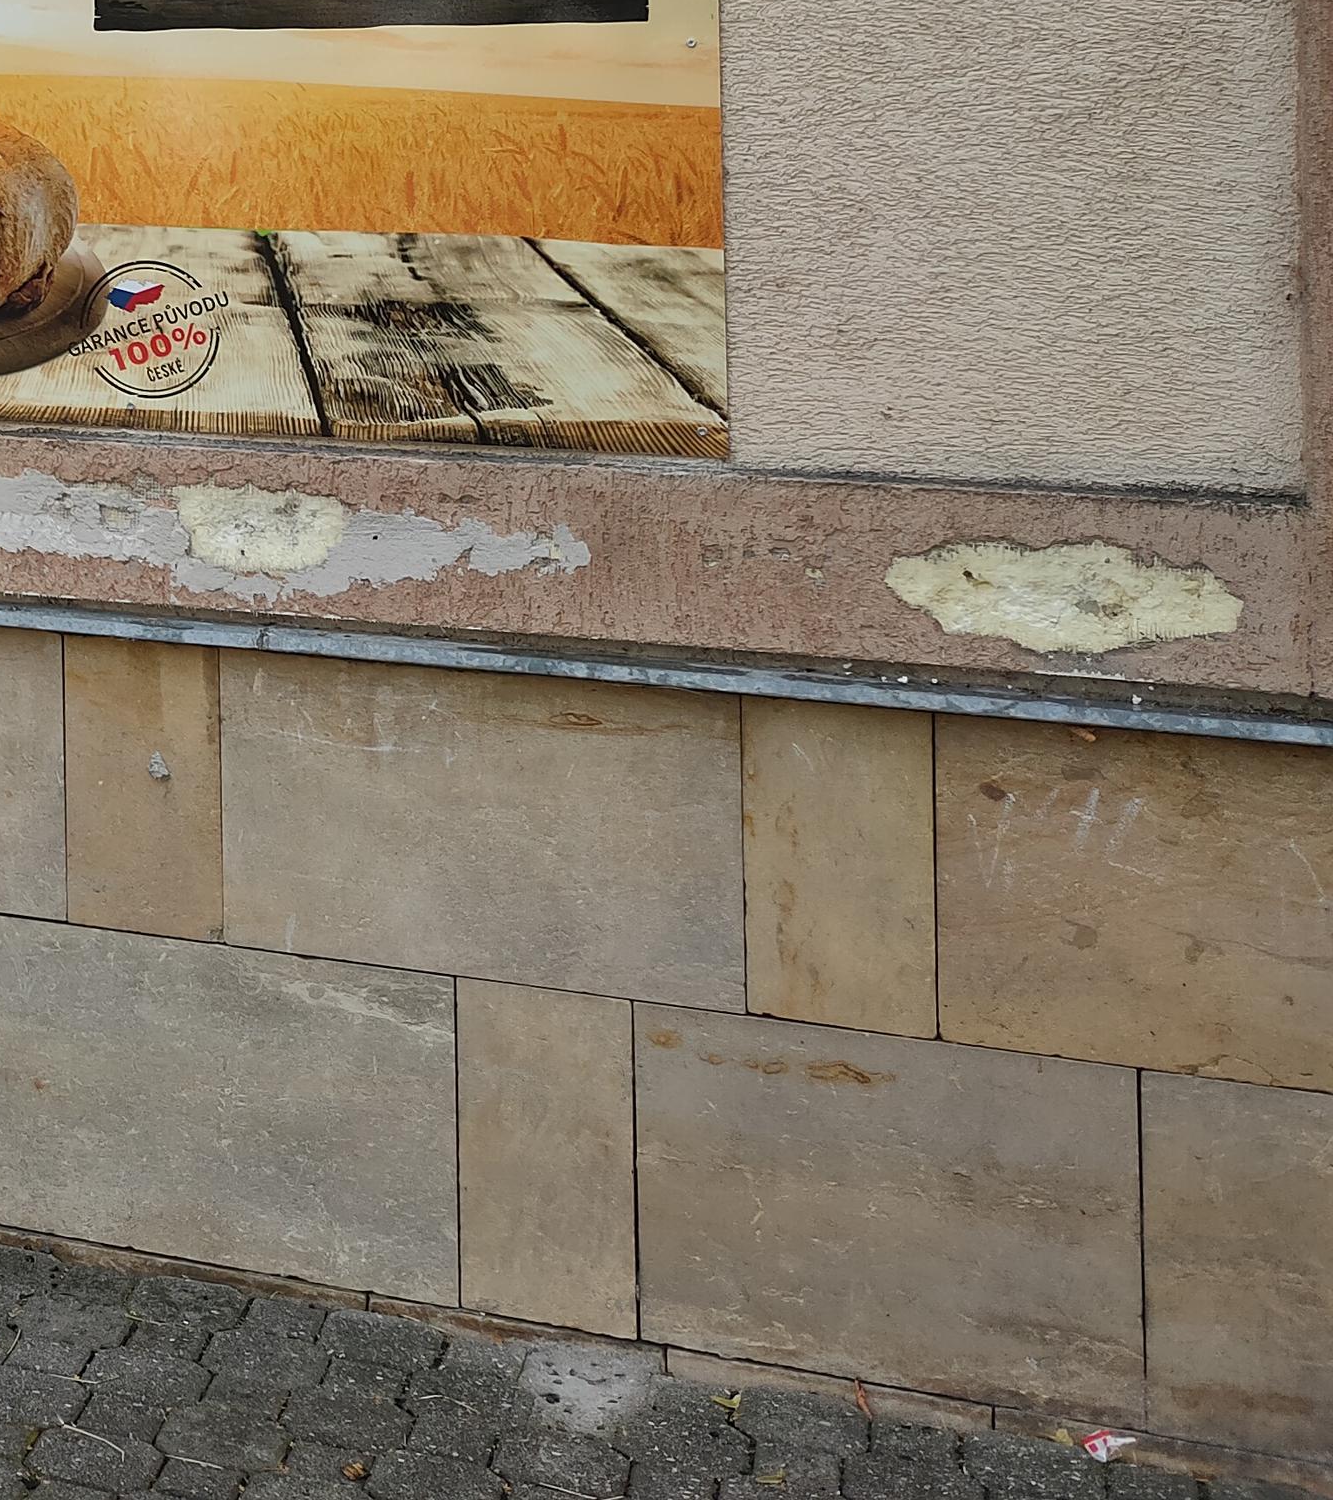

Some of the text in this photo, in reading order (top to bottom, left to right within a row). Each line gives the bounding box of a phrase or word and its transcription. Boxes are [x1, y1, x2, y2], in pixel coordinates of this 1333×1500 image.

[68, 290, 230, 358] GARANCE PŮVODU
[109, 322, 207, 372] 100%
[146, 357, 185, 383] ČESKÉ
